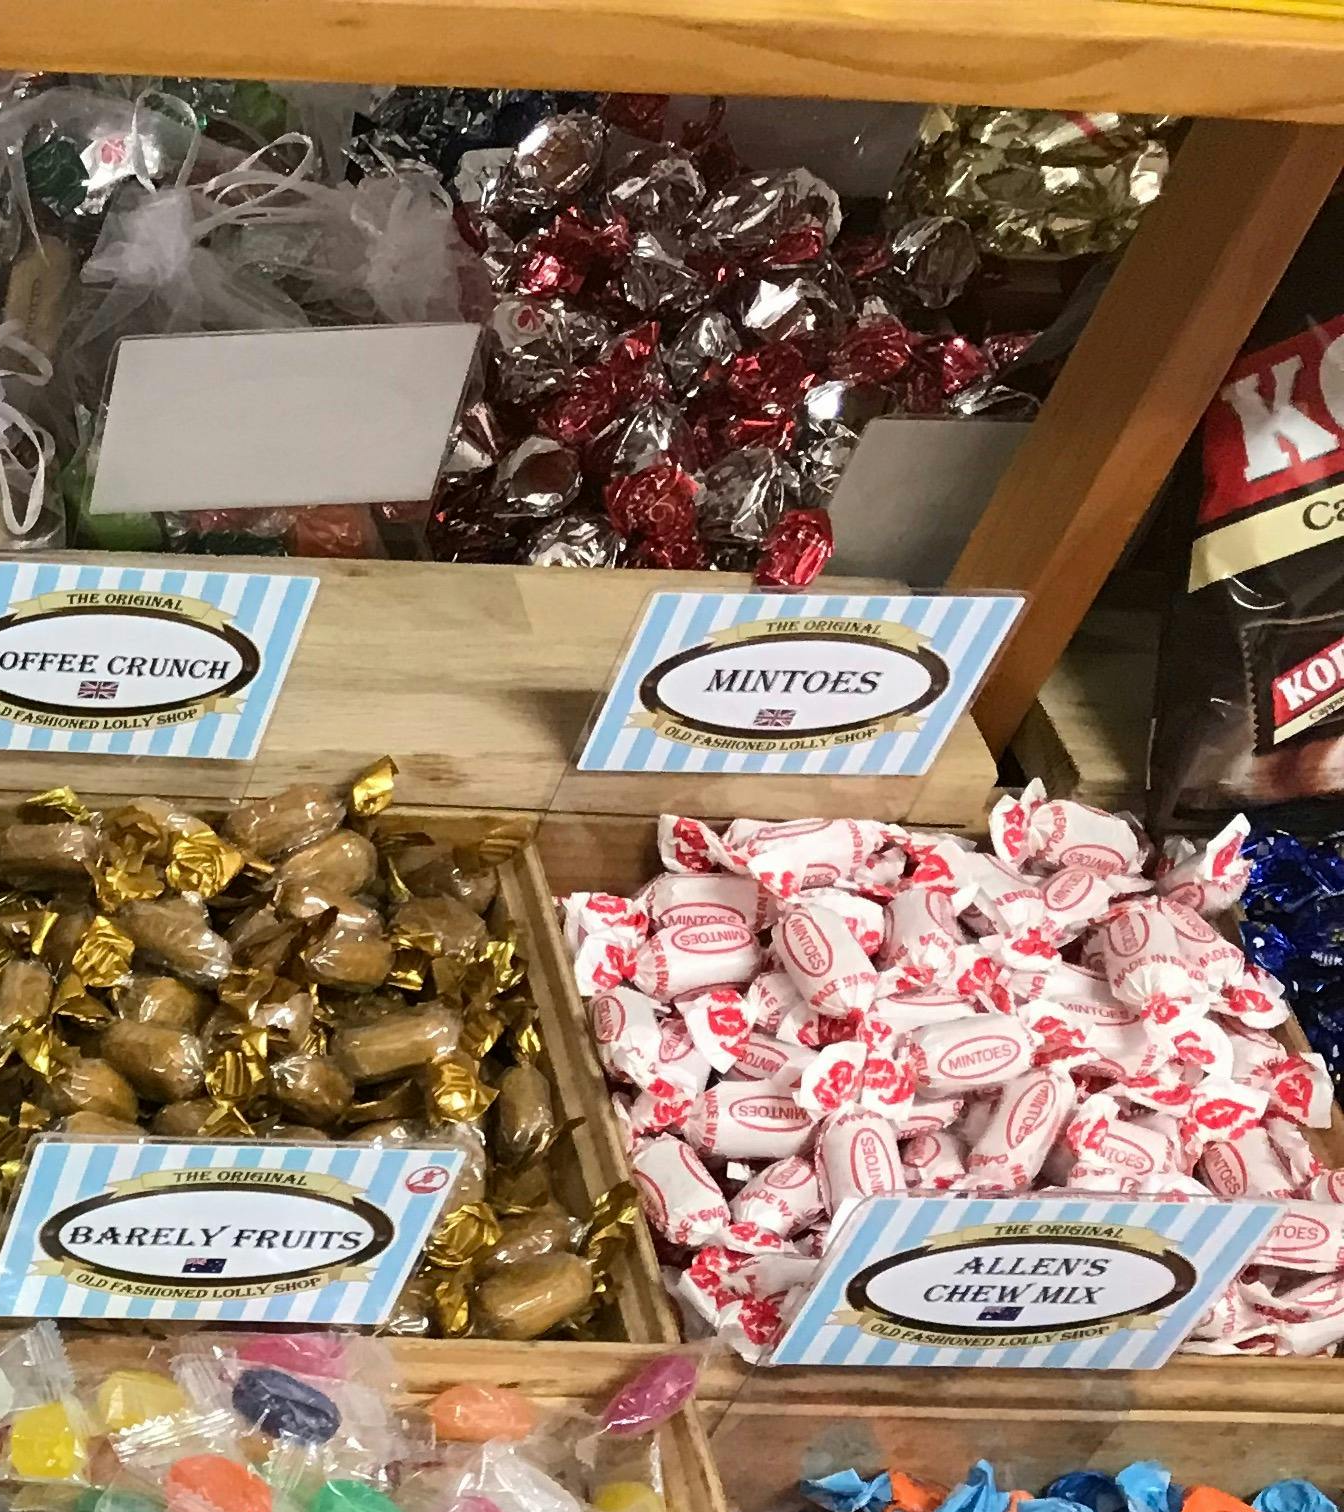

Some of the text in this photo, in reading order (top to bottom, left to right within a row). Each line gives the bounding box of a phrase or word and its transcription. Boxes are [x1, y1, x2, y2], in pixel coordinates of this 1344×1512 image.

[66, 593, 183, 611] THE ORIGINAL
[766, 620, 882, 635] THE ORIGINAL
[107, 655, 232, 680] CRUNCH
[704, 669, 884, 695] MINTOES
[12, 709, 99, 730] FASHIONED
[103, 715, 154, 730] LOLLY
[157, 709, 199, 725] SHOP
[664, 726, 878, 751] OLD FASHIONED LOLLY SHOP
[679, 928, 746, 946] MINTOES
[789, 917, 827, 972] MINTOES
[1113, 954, 1168, 989] MADE IN
[948, 1044, 1012, 1070] MINTOES
[738, 1104, 808, 1120] MINTOES
[172, 1170, 308, 1186] THE ORIGINAL
[67, 1226, 365, 1251] BARELY FRUITS
[993, 1224, 1124, 1239] THE ORIGINAL
[954, 1256, 1112, 1276] ALLEN'S
[76, 1273, 321, 1300] OLD FASHIONED LOLLY SHOP
[923, 1282, 1105, 1305] CHEW MIX
[870, 1323, 1111, 1348] OLD FASHIONED LOLLY SHOP
